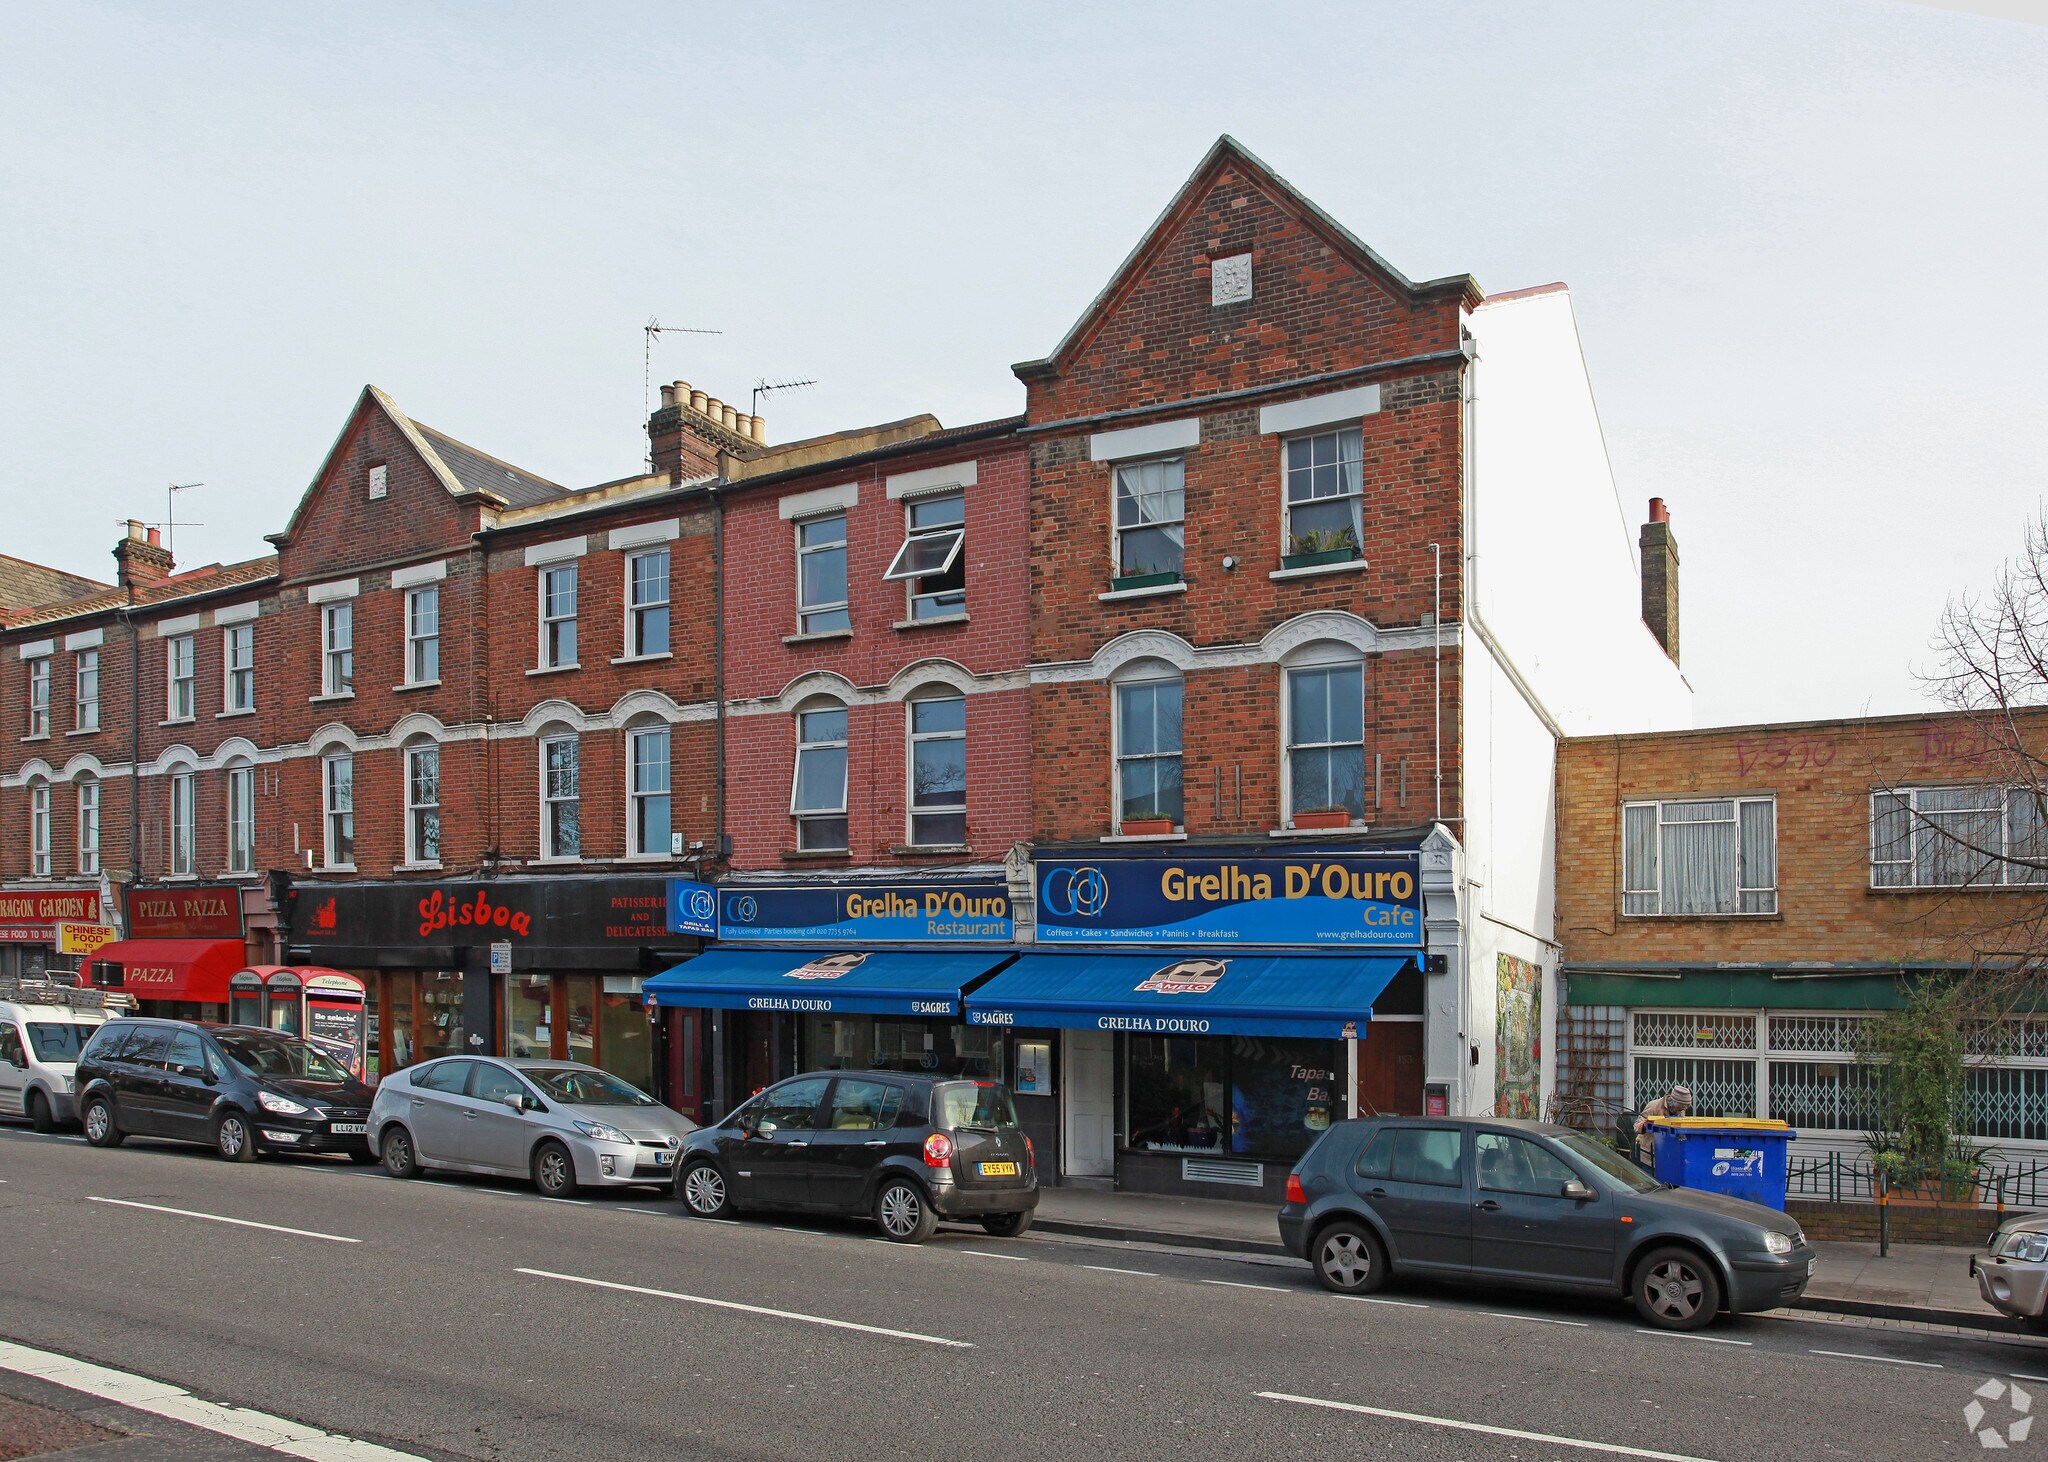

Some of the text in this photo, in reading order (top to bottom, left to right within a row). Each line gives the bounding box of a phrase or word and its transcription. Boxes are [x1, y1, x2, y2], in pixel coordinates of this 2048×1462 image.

[1161, 864, 1413, 901] Grelha D'Ouro
[40, 898, 84, 917] GARDEN
[138, 899, 228, 918] PIZZA PAZZA
[846, 891, 1006, 918] Grelha D'Ouro
[419, 889, 531, 936] Lisboa
[631, 913, 650, 921] AND
[1363, 905, 1414, 926] Cafe
[683, 920, 703, 928] GRILL
[927, 921, 1006, 935] Restaurant
[11, 930, 28, 939] FOOD
[31, 930, 39, 939] TO
[65, 925, 111, 936] CHINESE
[606, 926, 675, 937] DELICATESSE
[783, 928, 806, 936] booking
[1046, 929, 1239, 938] Coffees Cakes Sandwiches Paninis Breakfasts
[1316, 929, 1413, 941] www.grelhadouro.com
[73, 934, 103, 943] FOOD
[130, 967, 175, 983] PAZZA
[321, 978, 348, 986] Telephone
[1143, 981, 1209, 991] CAMELO
[748, 998, 832, 1011] GRELHA D'OURO
[920, 1002, 951, 1013] SAGRES
[314, 1012, 326, 1020] Be
[982, 1013, 1014, 1024] SAGRES
[1098, 1016, 1210, 1032] GRELHA D'OURO
[336, 1124, 353, 1132] LL12
[983, 1164, 1001, 1174] EY55
